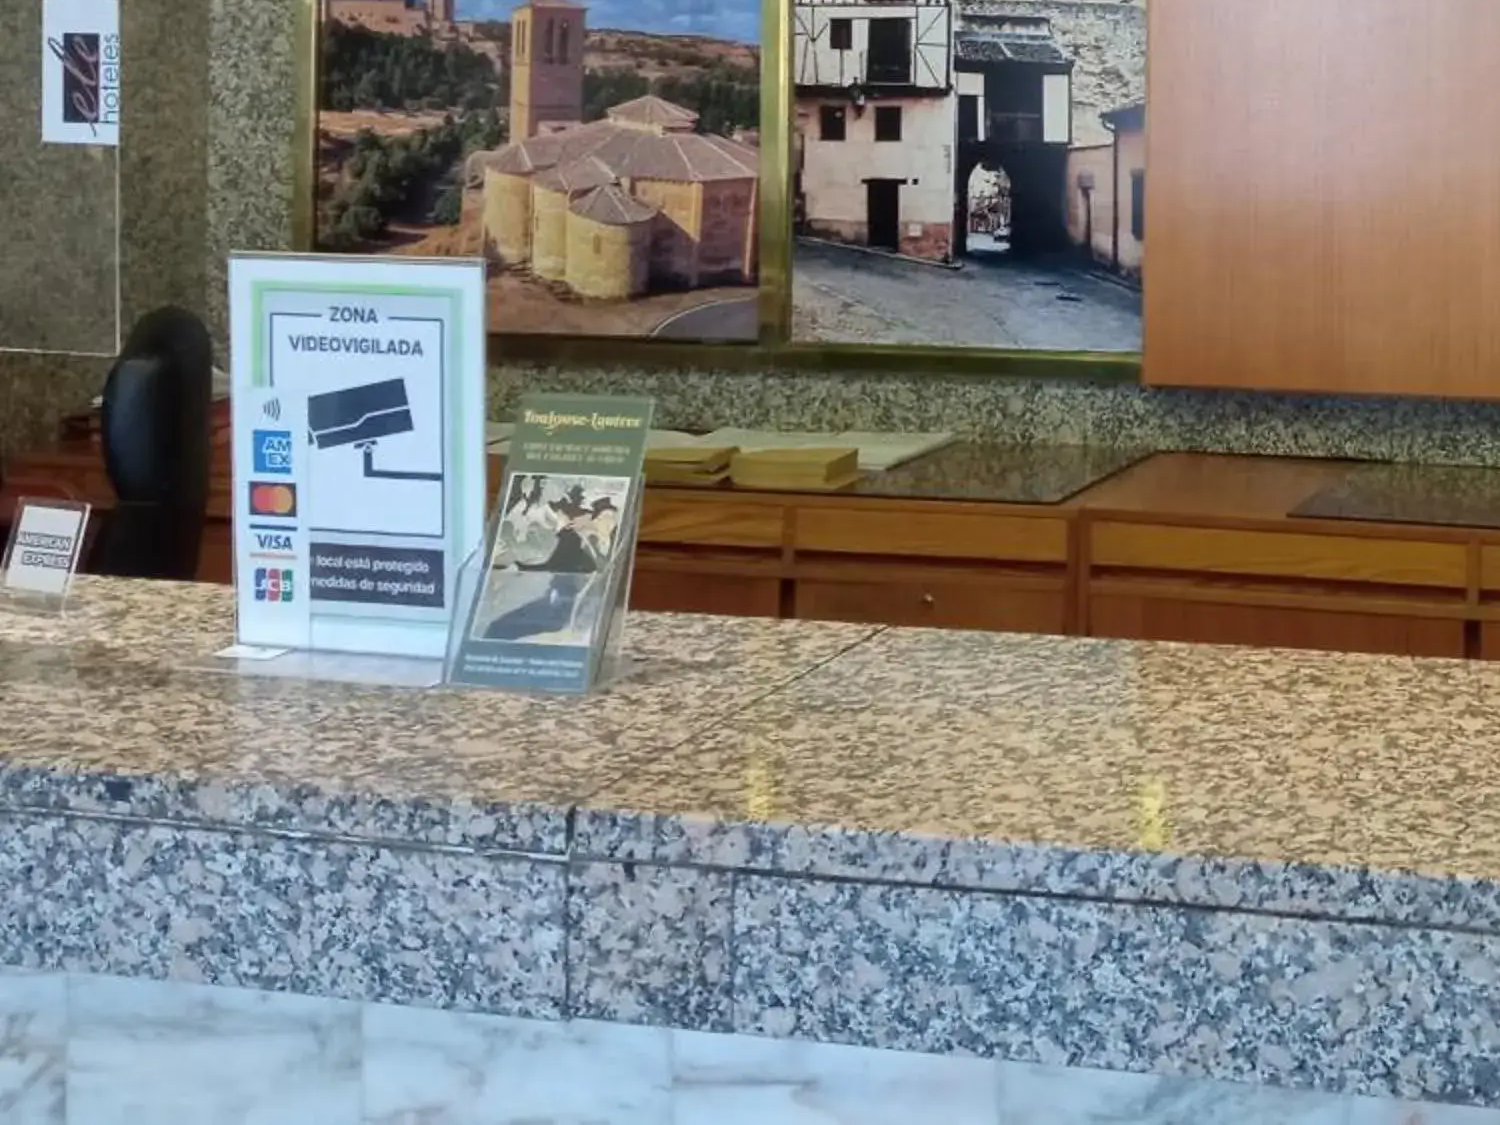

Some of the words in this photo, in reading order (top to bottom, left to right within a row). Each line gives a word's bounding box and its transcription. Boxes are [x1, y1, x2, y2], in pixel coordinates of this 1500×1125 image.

[100, 33, 119, 124] hoteles
[328, 306, 379, 324] ZONA
[288, 334, 424, 357] VIDEOVIGILADA
[263, 437, 291, 453] AM
[266, 452, 291, 467] EX
[257, 534, 293, 551] VISA
[316, 555, 343, 568] local
[344, 556, 371, 570] está
[372, 559, 430, 576] protegido
[359, 578, 375, 591] de
[376, 581, 436, 596] seguridad
